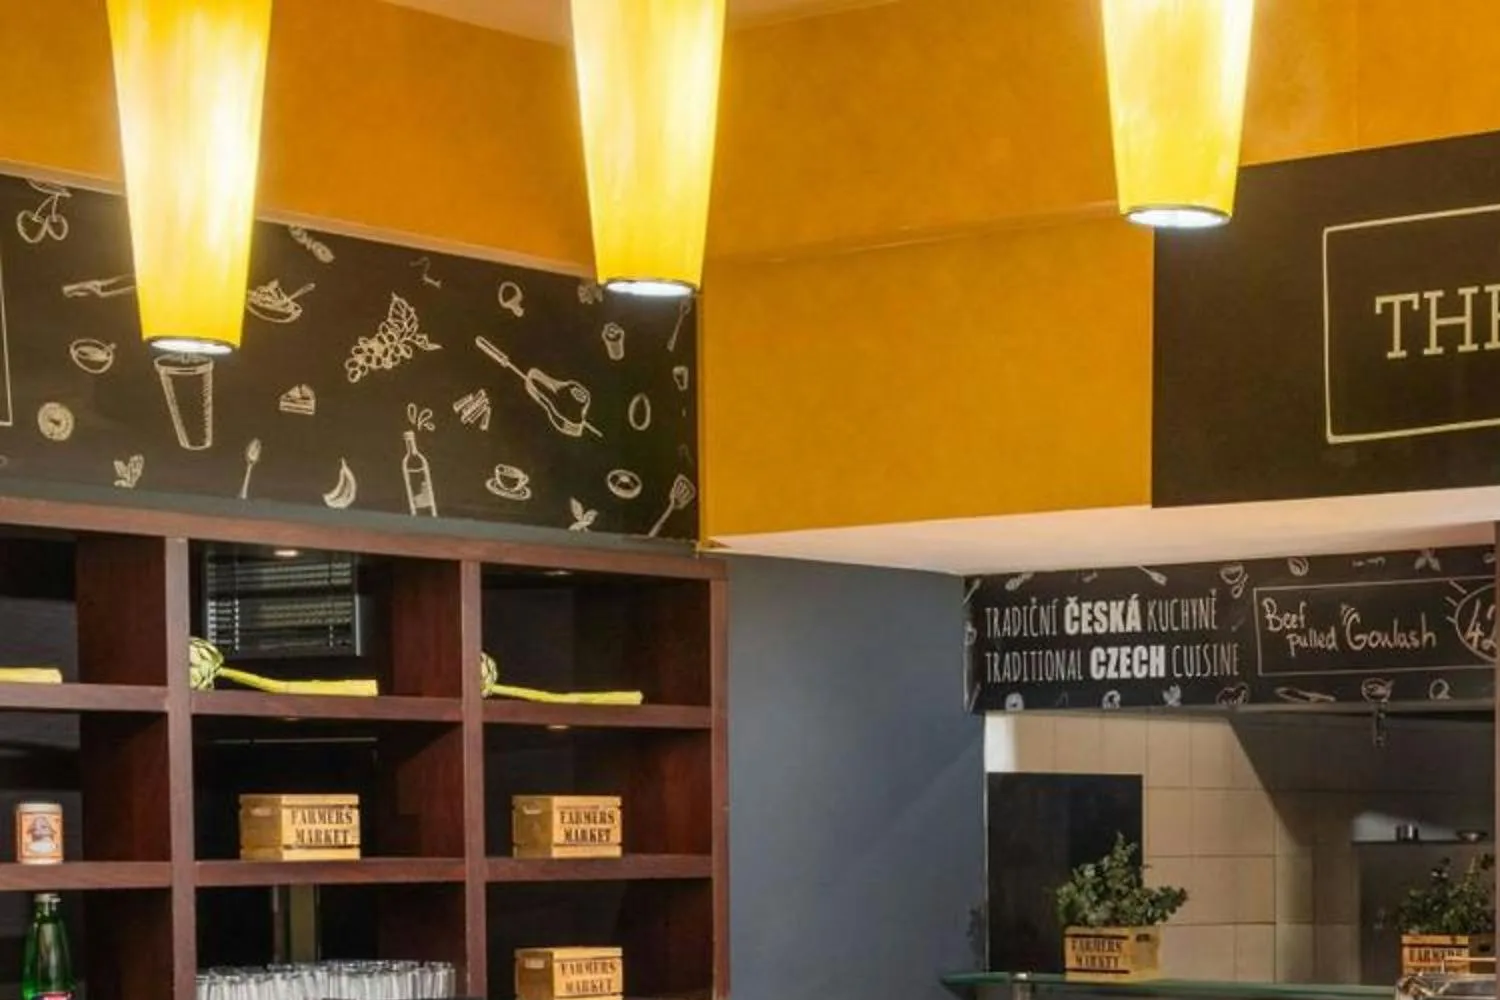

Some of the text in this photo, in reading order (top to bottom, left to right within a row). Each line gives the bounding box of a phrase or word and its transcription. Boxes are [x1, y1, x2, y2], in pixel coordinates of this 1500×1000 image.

[984, 597, 1059, 638] TRADIČNÍ
[1064, 593, 1142, 635] ČESKÁ
[1262, 597, 1307, 632] Beef
[1286, 626, 1339, 658] pulled
[984, 643, 1240, 683] TRADITIONAL CZECH CUISINE
[291, 807, 354, 825] FARMERS
[560, 809, 615, 825] FARMERS
[295, 828, 351, 845] MARKET
[563, 827, 612, 843] MARKET
